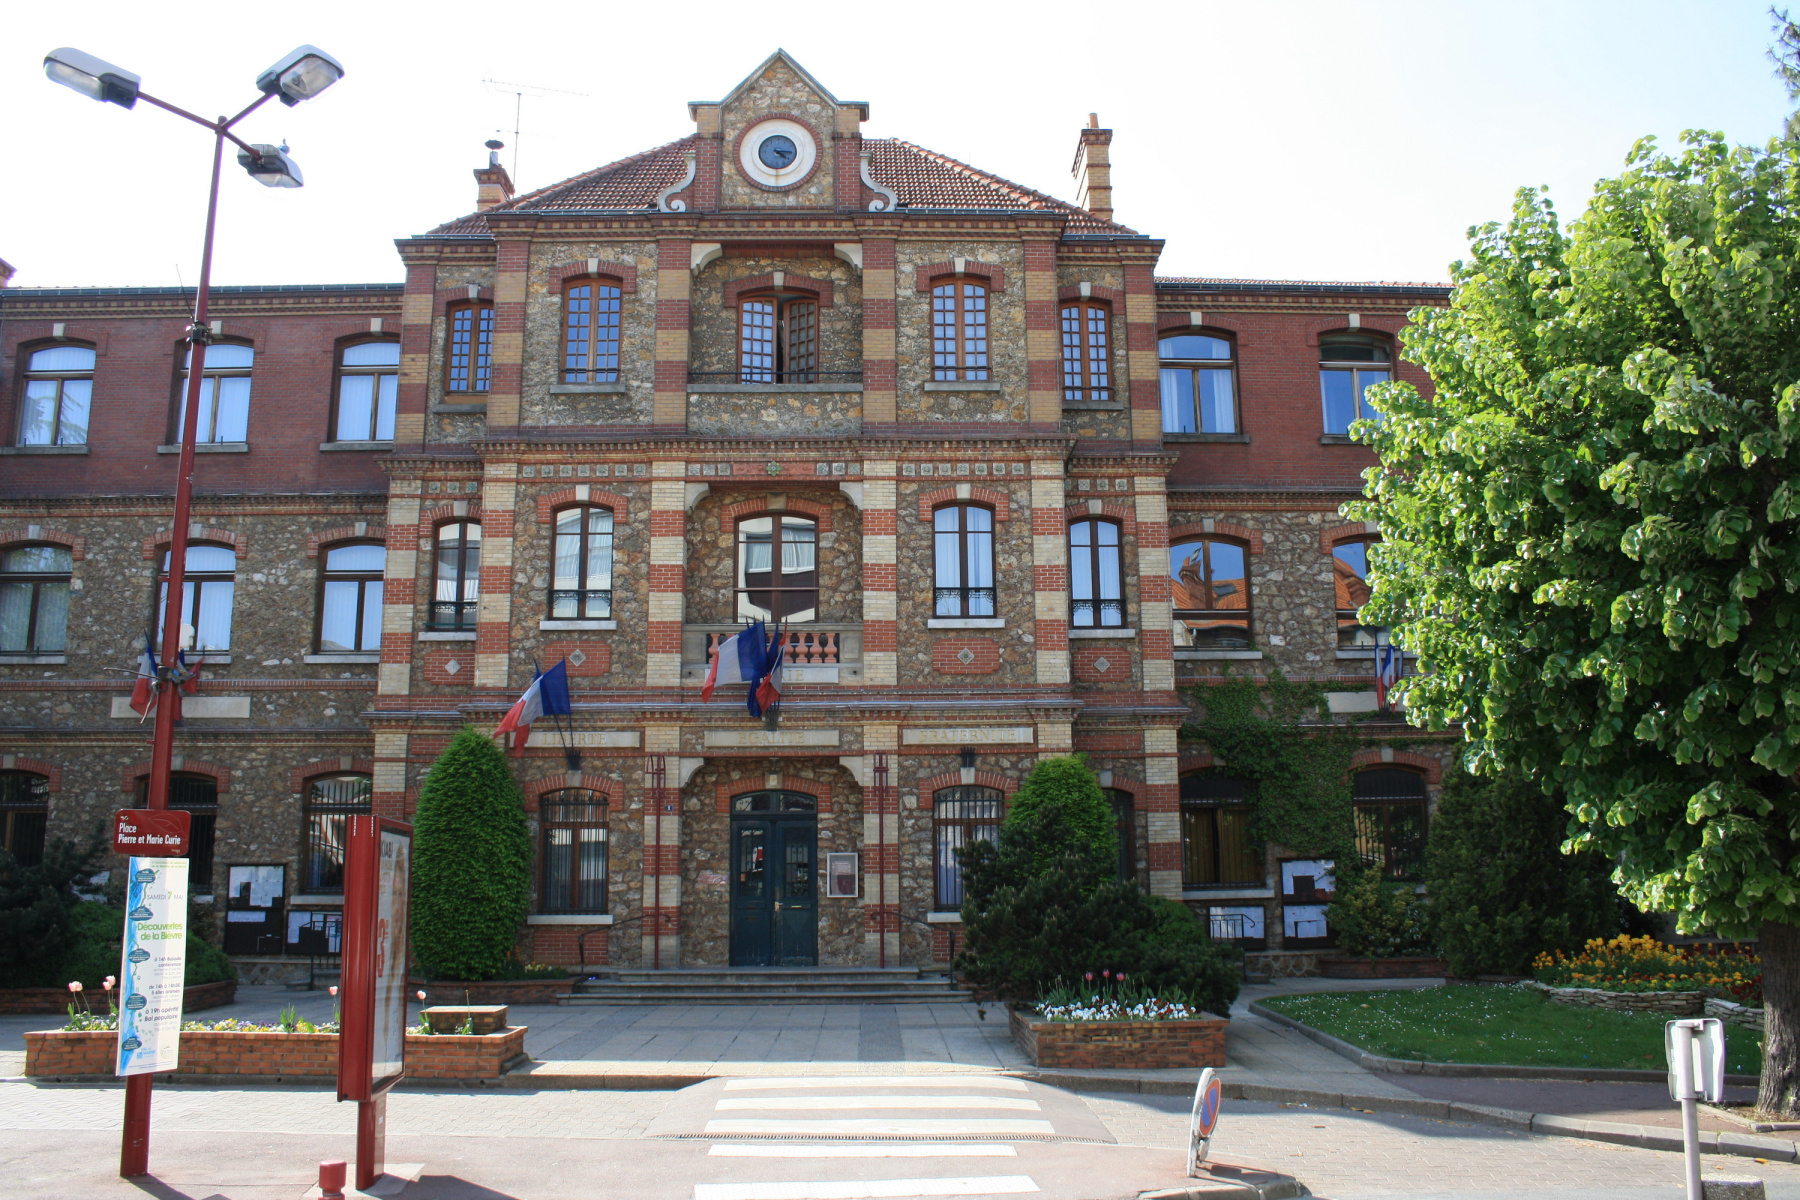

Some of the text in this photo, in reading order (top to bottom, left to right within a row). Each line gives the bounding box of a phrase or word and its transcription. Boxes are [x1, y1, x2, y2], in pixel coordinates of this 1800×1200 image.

[920, 729, 1017, 742] FRATERNITE
[119, 822, 137, 833] Place
[118, 833, 181, 845] Pierre et Marie Curie
[167, 891, 173, 900] 7
[137, 921, 183, 931] Découvertes
[140, 931, 183, 941] de la Bièvre
[154, 1014, 178, 1022] populaire
